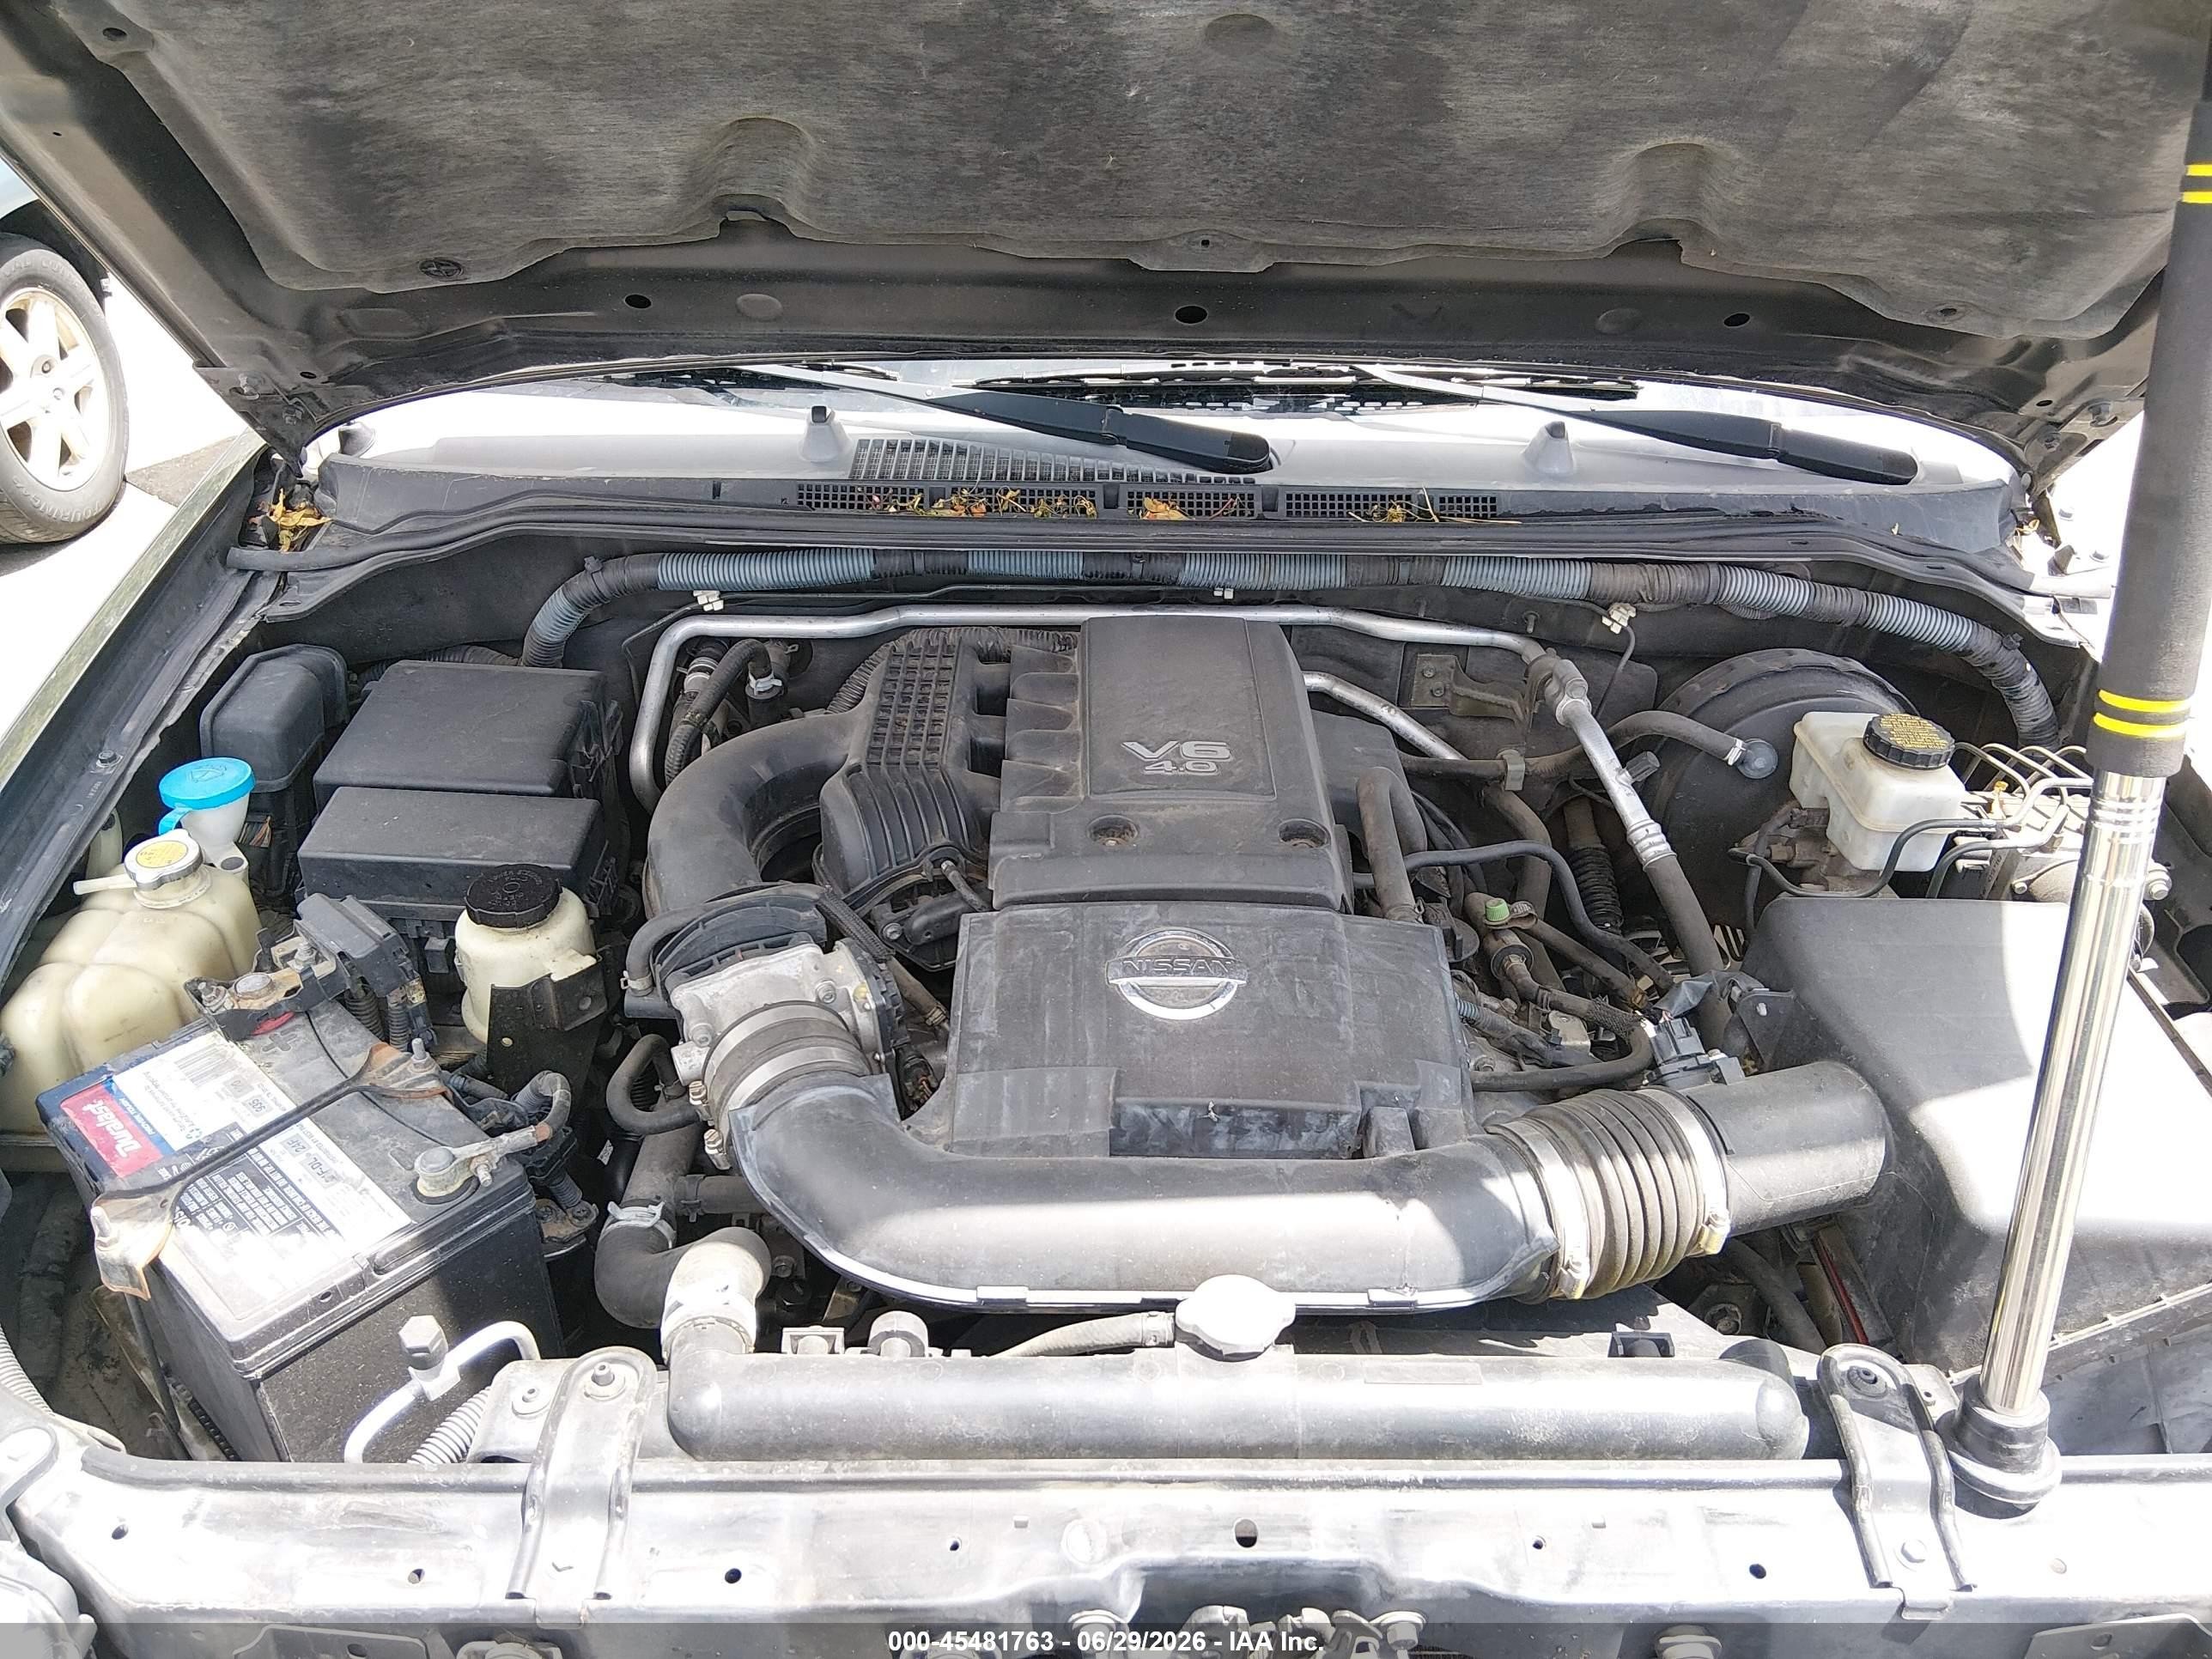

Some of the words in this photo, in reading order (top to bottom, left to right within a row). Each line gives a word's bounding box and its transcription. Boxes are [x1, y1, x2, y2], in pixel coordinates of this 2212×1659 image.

[1122, 740, 1231, 761] V6
[1144, 762, 1218, 775] 4.0
[1122, 958, 1235, 973] NISSAN
[81, 1098, 144, 1158] Duralast
